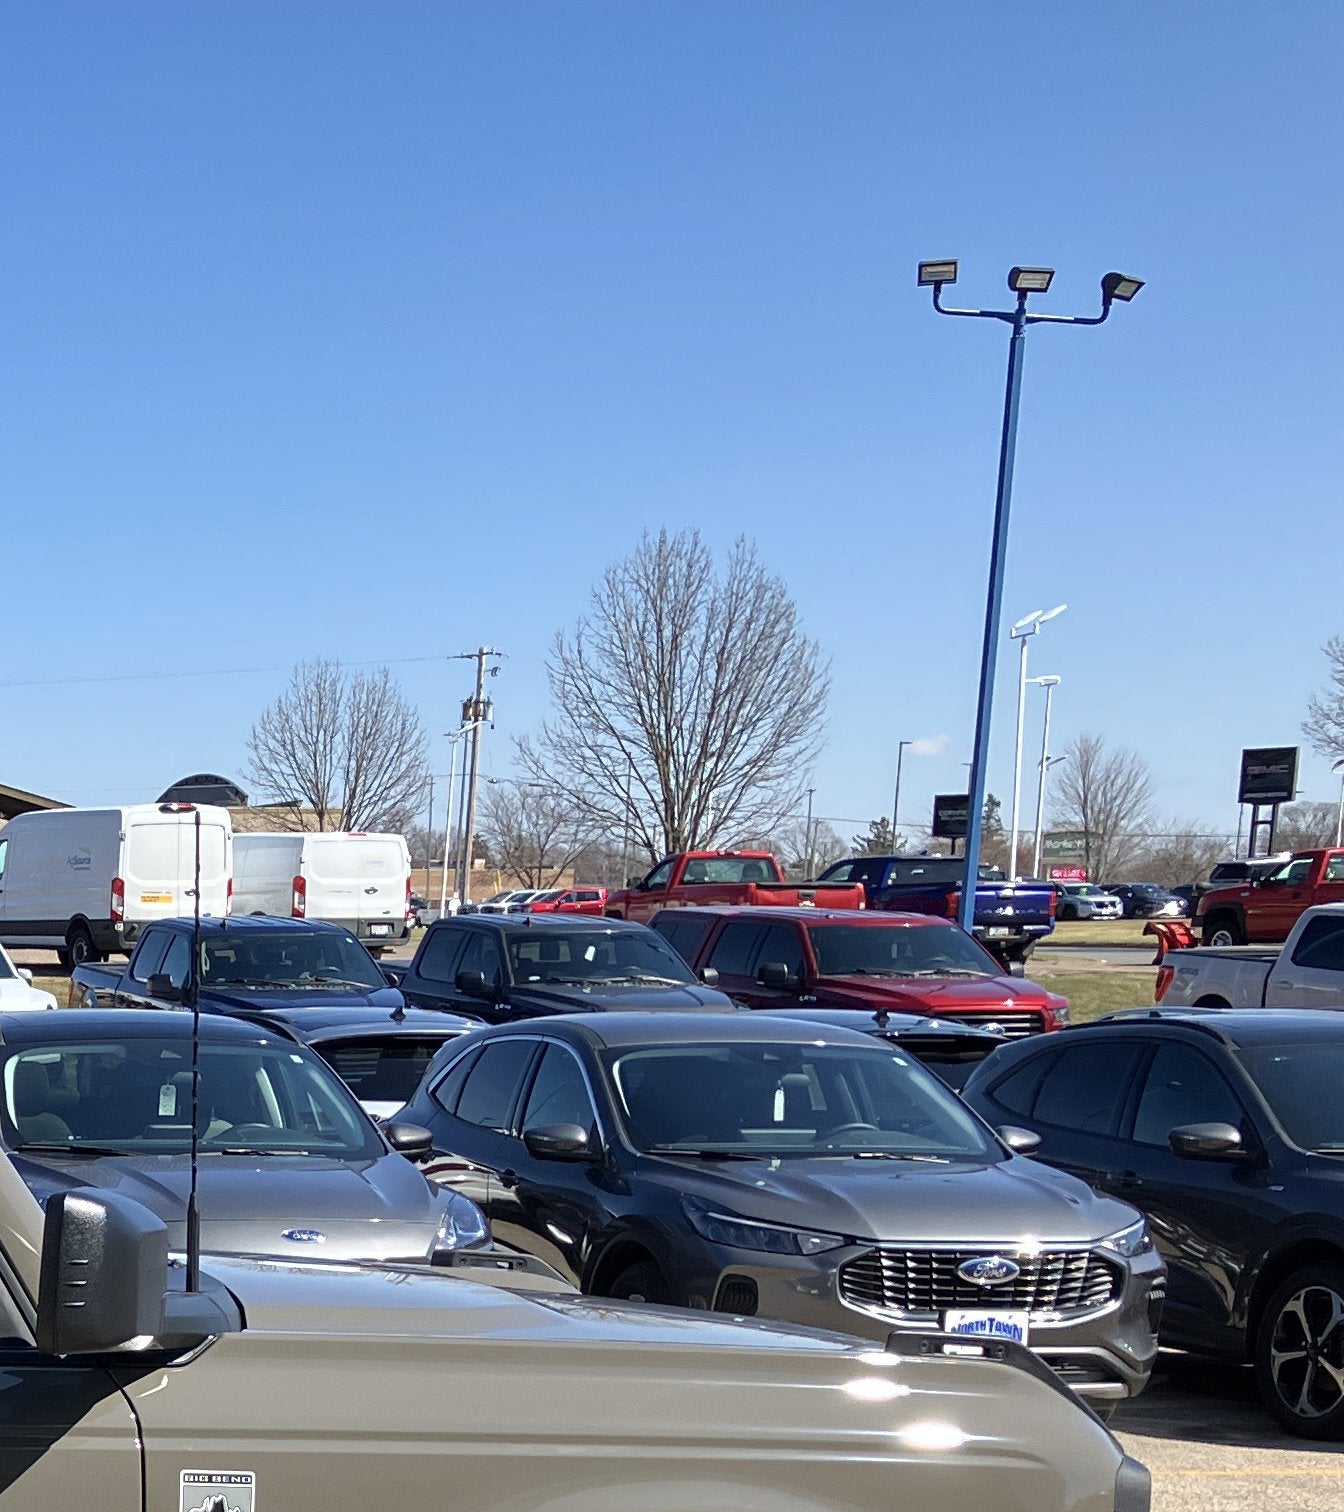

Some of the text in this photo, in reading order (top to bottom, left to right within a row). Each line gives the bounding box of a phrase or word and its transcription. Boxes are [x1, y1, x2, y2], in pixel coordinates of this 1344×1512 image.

[987, 1317, 1022, 1342] TOWN
[184, 1474, 251, 1483] BIG BEND
